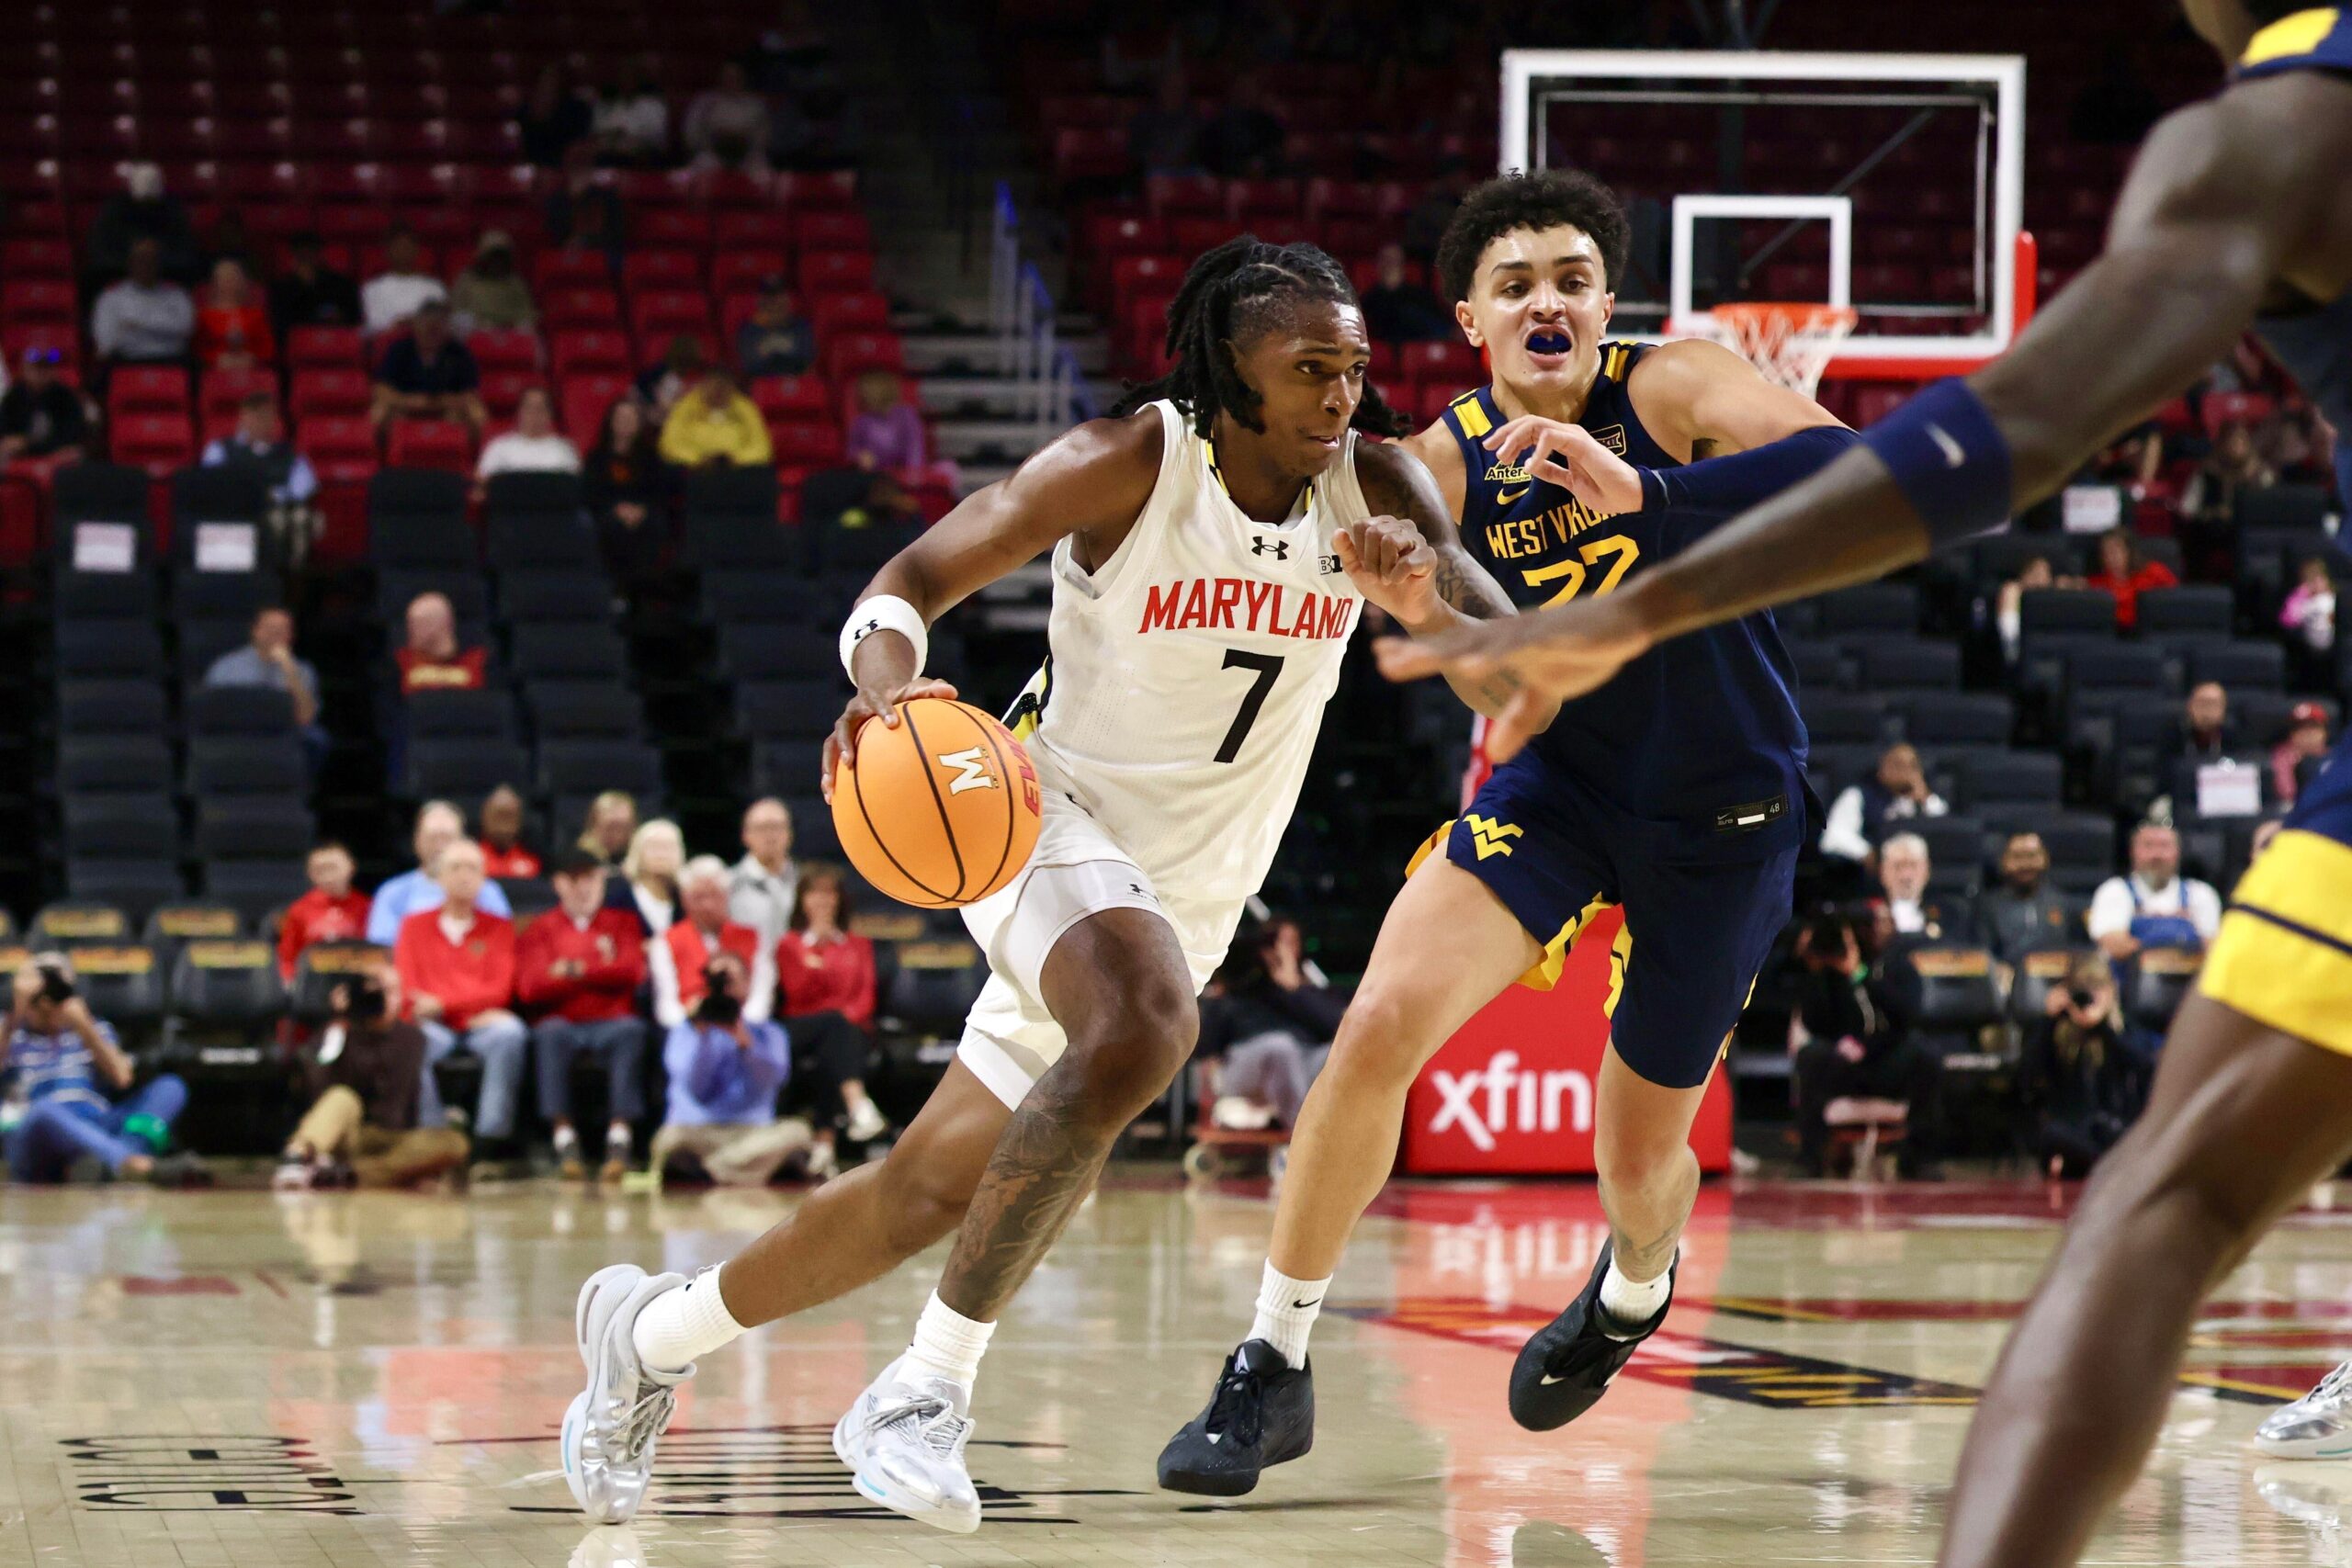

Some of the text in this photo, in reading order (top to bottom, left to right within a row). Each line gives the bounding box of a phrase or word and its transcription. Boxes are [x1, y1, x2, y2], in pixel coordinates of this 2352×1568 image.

[1486, 467, 1529, 479] Anter
[1485, 513, 1548, 559] WEST
[1317, 555, 1343, 575] B1
[1137, 578, 1353, 639] MARYLAND
[1213, 648, 1285, 764] 7
[1429, 1049, 1594, 1152] xfin
